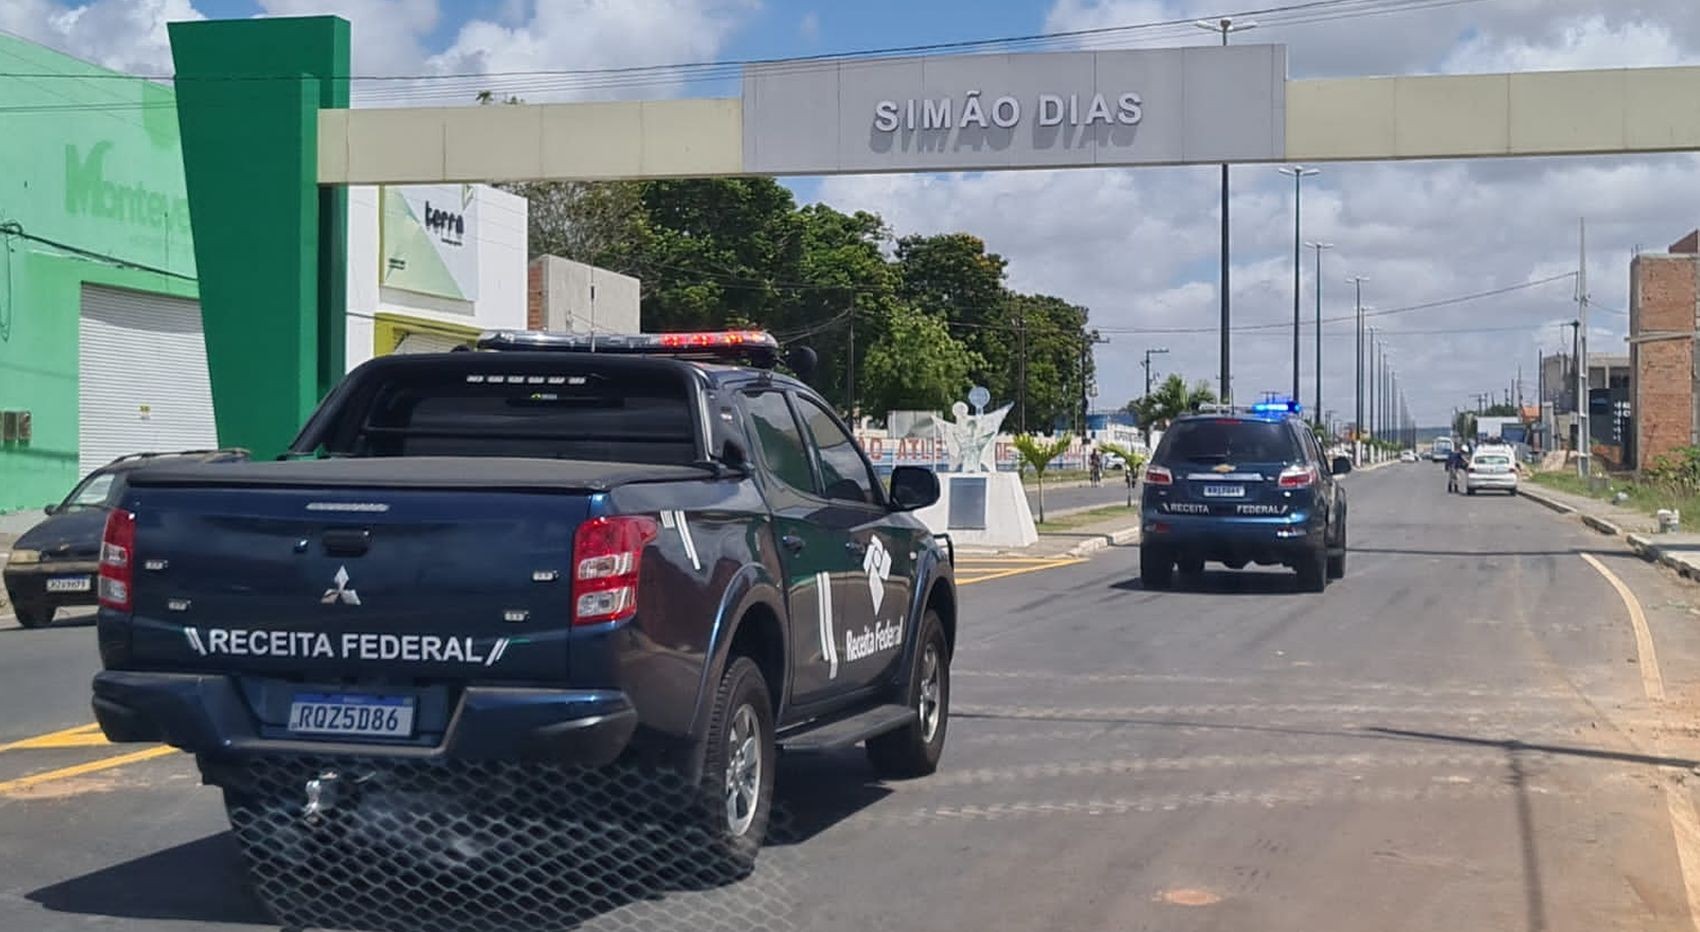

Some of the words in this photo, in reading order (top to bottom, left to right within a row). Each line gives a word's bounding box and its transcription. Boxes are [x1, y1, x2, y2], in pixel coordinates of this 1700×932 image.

[874, 90, 1021, 132] SIMÃO
[1039, 92, 1143, 126] DIAS
[425, 200, 464, 234] terra
[1170, 503, 1209, 514] RECEITA
[1236, 504, 1279, 514] FEDERAL
[208, 627, 335, 659] RECEITA
[341, 631, 484, 663] FEDERAL
[847, 625, 874, 661] Receita
[876, 615, 904, 652] Federal
[299, 705, 399, 731] RQZ5D86
